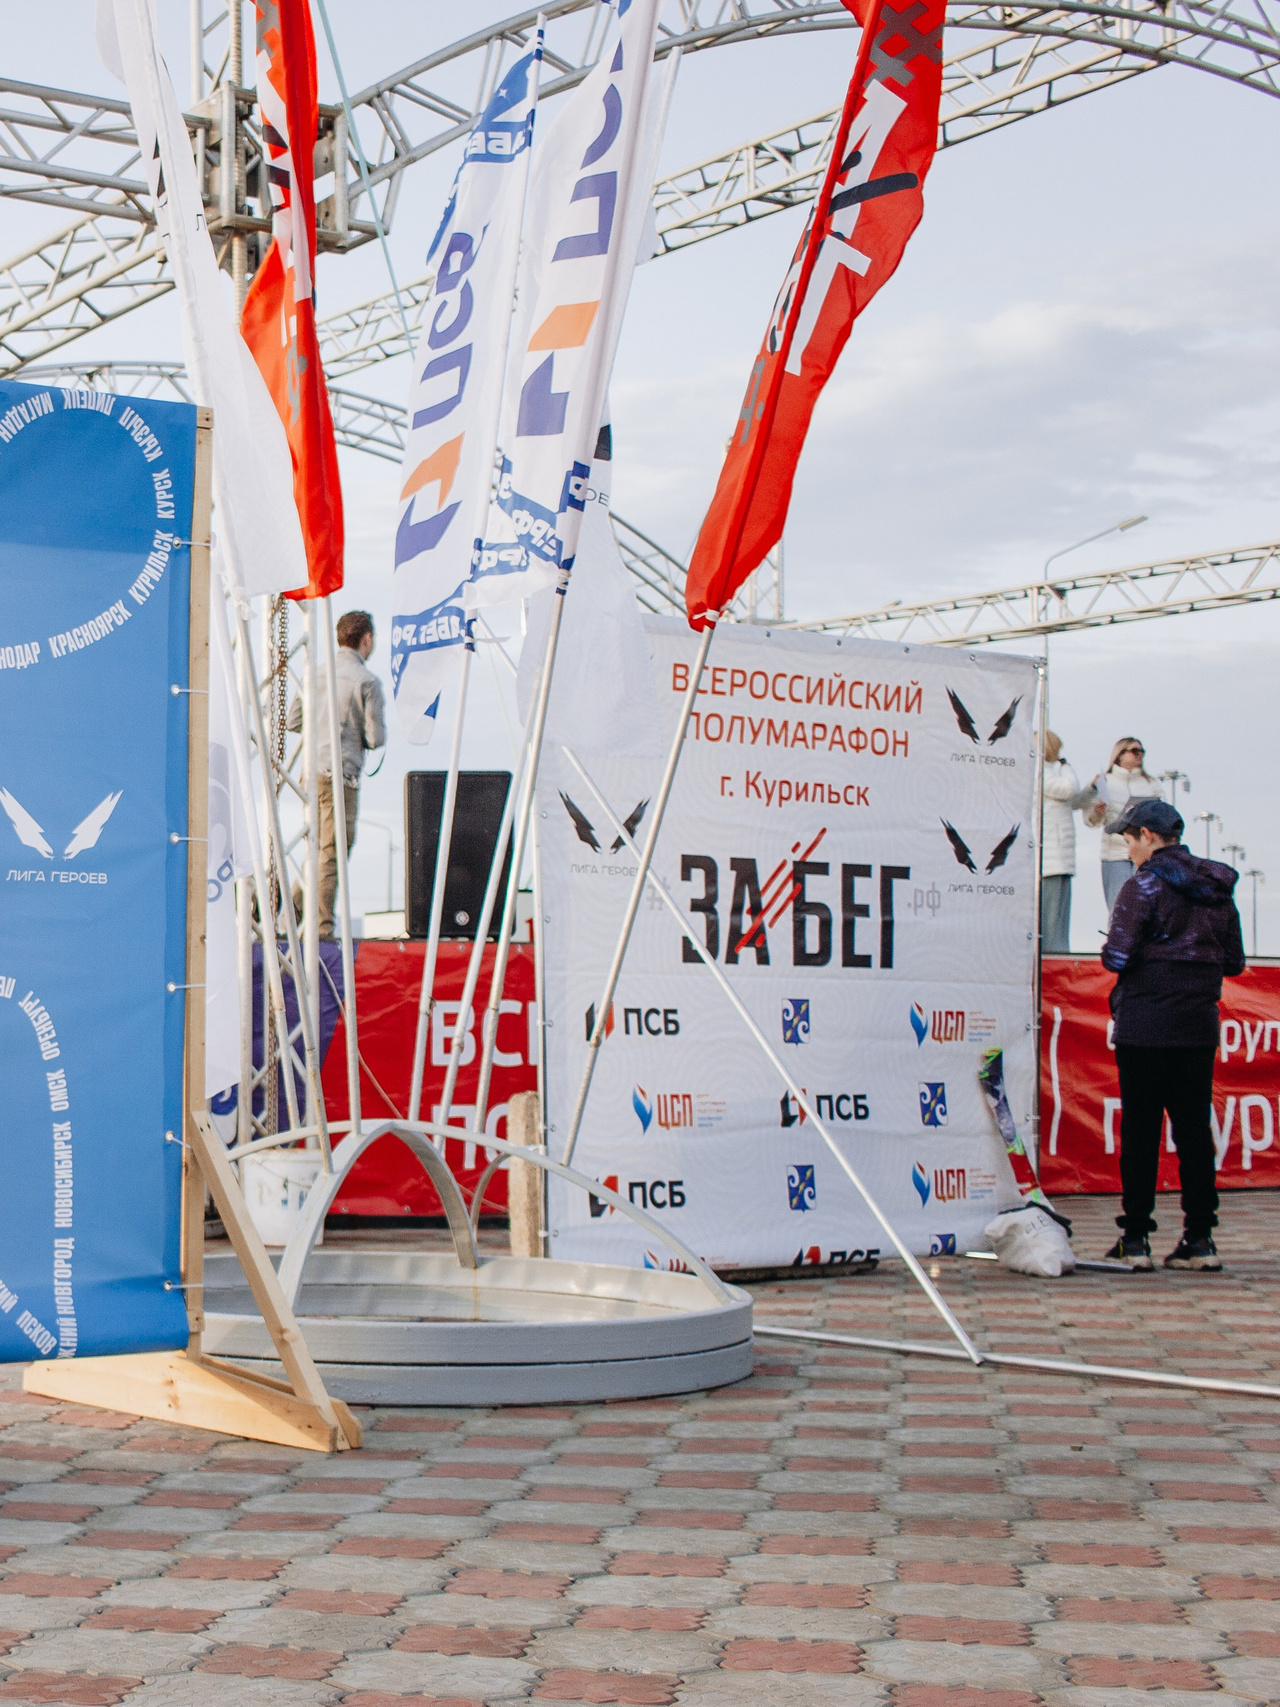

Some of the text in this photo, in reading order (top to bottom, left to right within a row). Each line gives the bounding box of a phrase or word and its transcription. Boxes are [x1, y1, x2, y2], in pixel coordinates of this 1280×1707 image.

[61, 388, 116, 416] ЛИПЕЦК
[118, 406, 163, 463] КЫЗЫЛ
[152, 468, 175, 519] КУРСК
[128, 530, 174, 605] КУРИЛЬСК
[49, 600, 132, 658] КРАСНОЯРСК
[950, 752, 1016, 767] ЛИГА ГЕРОЕВ
[720, 770, 870, 807] г. Курильск
[6, 870, 108, 884] ЛИГА ГЕРОЕВ
[570, 863, 642, 877] ЛИГА ГЕРОЕ
[947, 883, 1015, 896] ЛИГА ГЕРОЕВ
[907, 883, 942, 917] .рф
[18, 990, 60, 1061] ОРЕНБУРГ
[624, 1007, 681, 1037] ПСБ
[931, 1010, 965, 1043] ЦСП
[47, 1068, 70, 1112] ОМСК
[657, 1093, 694, 1130] ЦСП
[816, 1094, 870, 1122] ПСБ
[52, 1121, 74, 1228] НОВОСИБИРСК
[629, 1179, 686, 1209] ПСБ
[934, 1167, 966, 1201] ЦСП
[54, 1237, 75, 1315] НОВГОРОД
[16, 1309, 58, 1356] ПСКОВ
